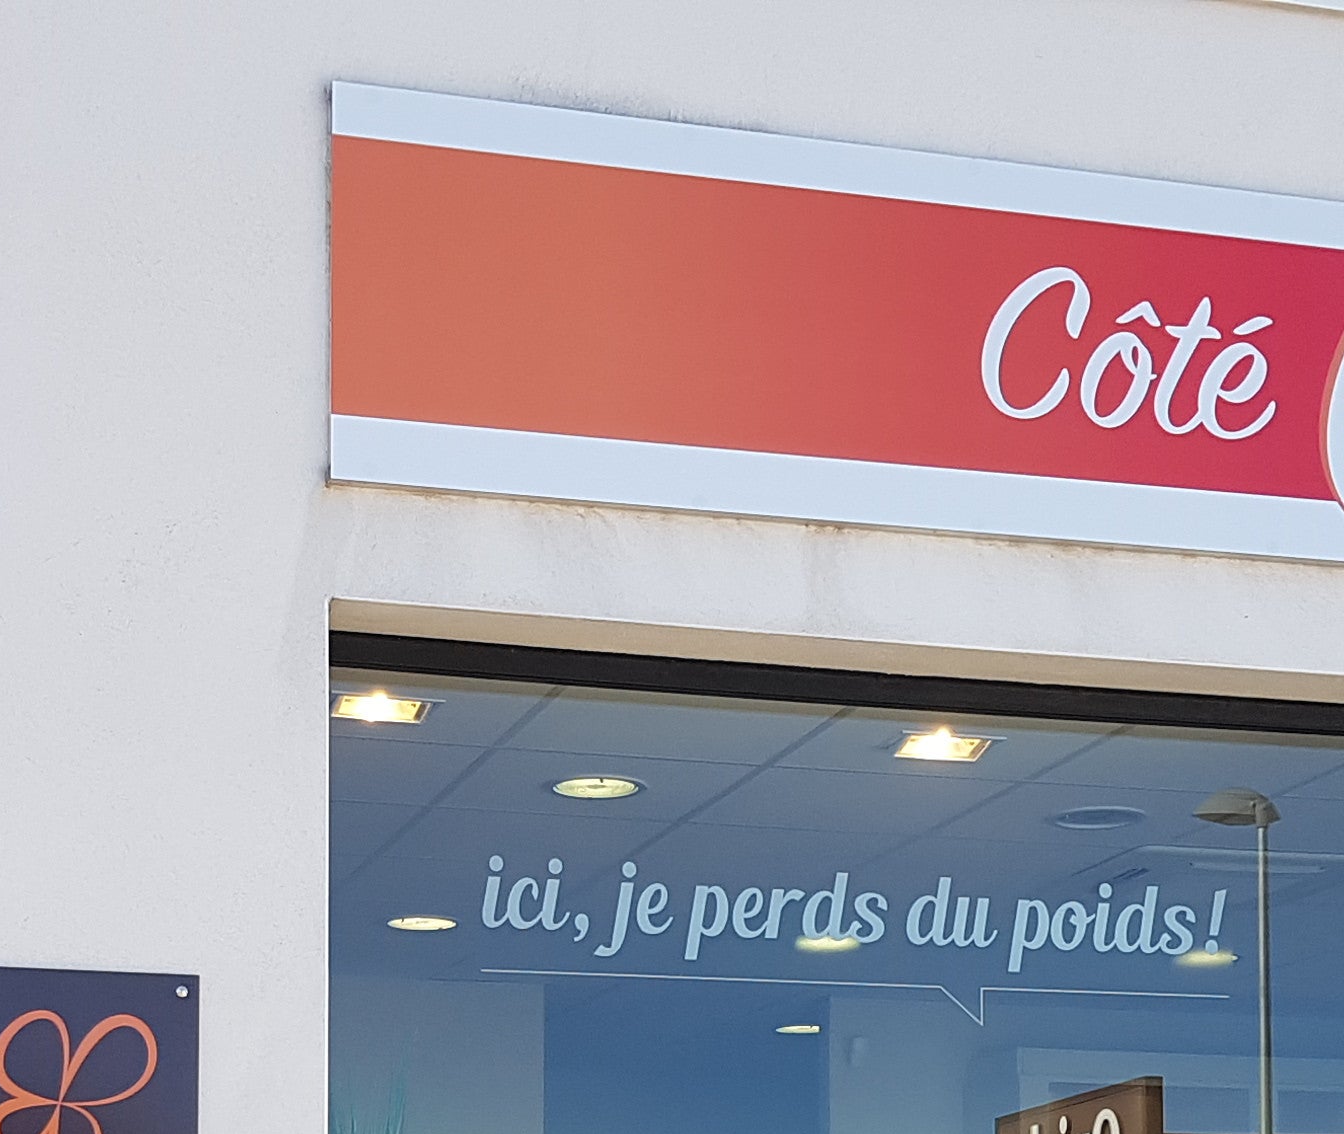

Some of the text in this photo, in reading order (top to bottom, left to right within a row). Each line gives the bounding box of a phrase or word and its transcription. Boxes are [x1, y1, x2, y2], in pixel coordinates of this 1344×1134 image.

[980, 266, 1275, 441] Côté
[480, 854, 588, 943] ici,
[595, 861, 672, 958] je
[683, 871, 887, 961] perds
[905, 876, 998, 949] du
